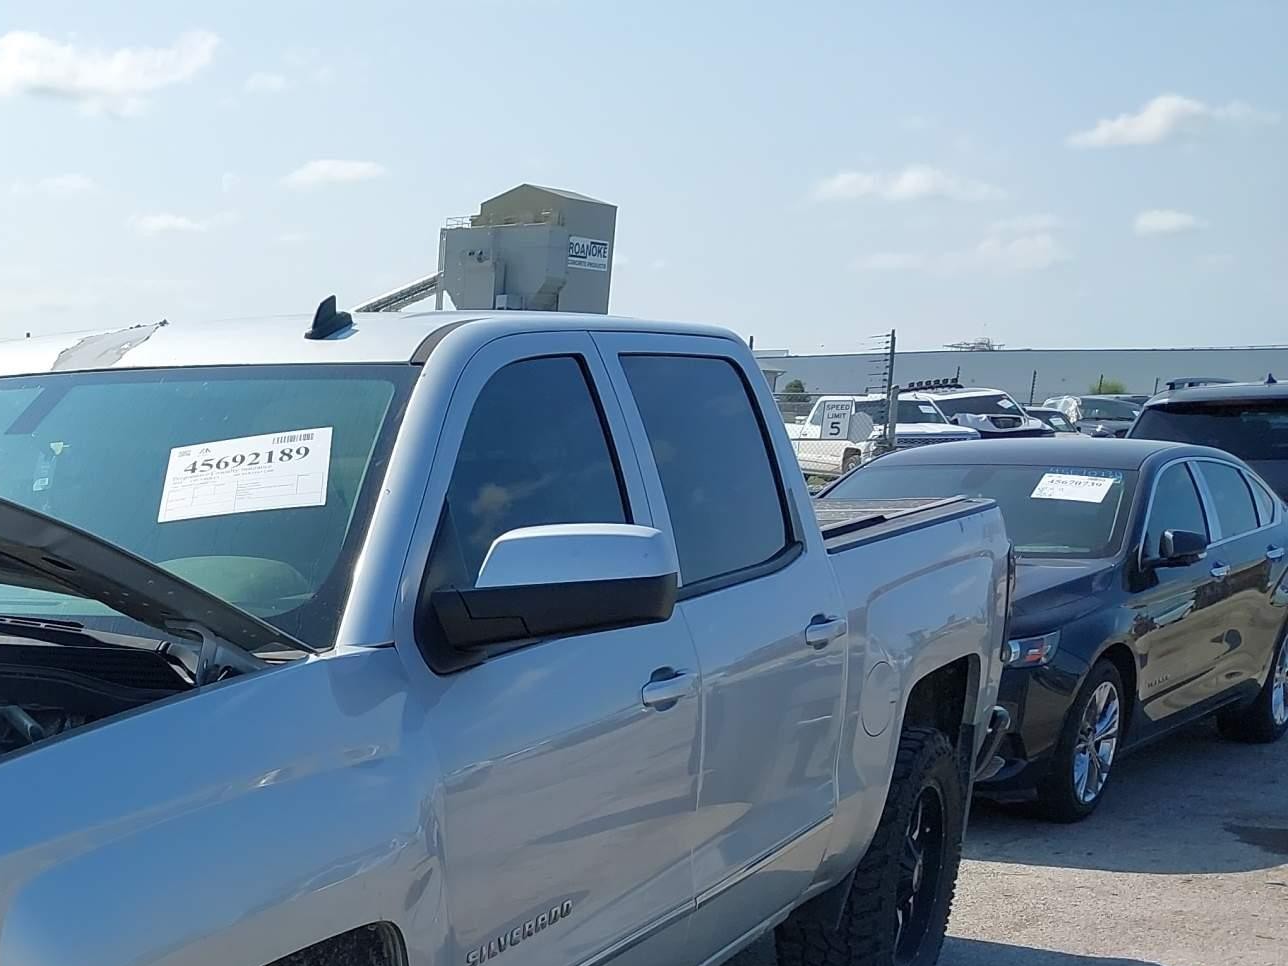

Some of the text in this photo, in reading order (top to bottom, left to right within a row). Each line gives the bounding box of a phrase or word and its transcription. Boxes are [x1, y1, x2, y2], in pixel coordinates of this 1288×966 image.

[569, 242, 608, 259] ROANOKE
[829, 422, 841, 436] 5
[184, 446, 310, 475] 45692189
